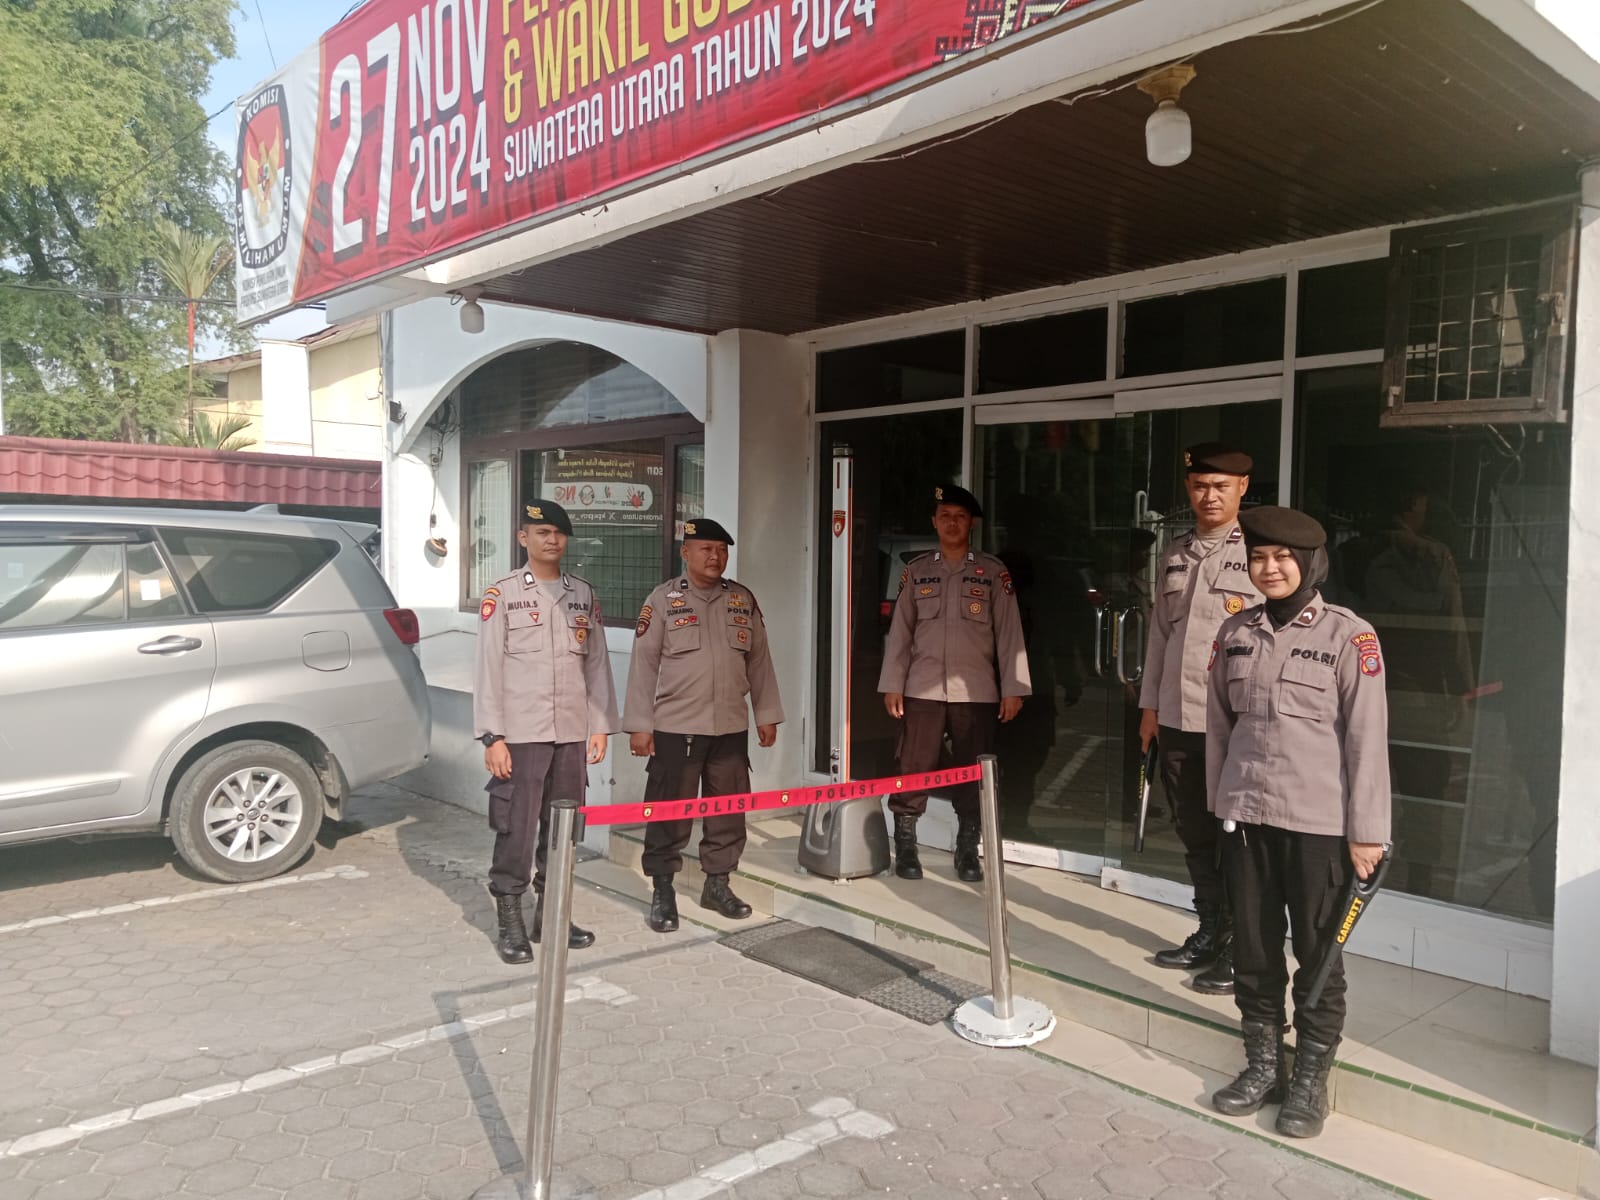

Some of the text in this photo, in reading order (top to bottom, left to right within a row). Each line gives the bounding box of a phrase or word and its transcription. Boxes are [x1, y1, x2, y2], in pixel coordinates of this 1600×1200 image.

[246, 87, 280, 121] KOMISI
[408, 0, 489, 129] NOV
[504, 38, 523, 123] &
[531, 0, 650, 109] WAKIL
[504, 92, 604, 182] SUMATERA
[610, 53, 685, 137] UTARA
[692, 5, 781, 101] TAHUN
[330, 22, 401, 254] 27
[409, 100, 491, 222] 2024
[237, 175, 292, 265] PEMILIHAN UMUM
[1224, 561, 1248, 572] POL
[1290, 647, 1337, 666] POLRI
[685, 768, 977, 814] POLISI POLISI POLISI
